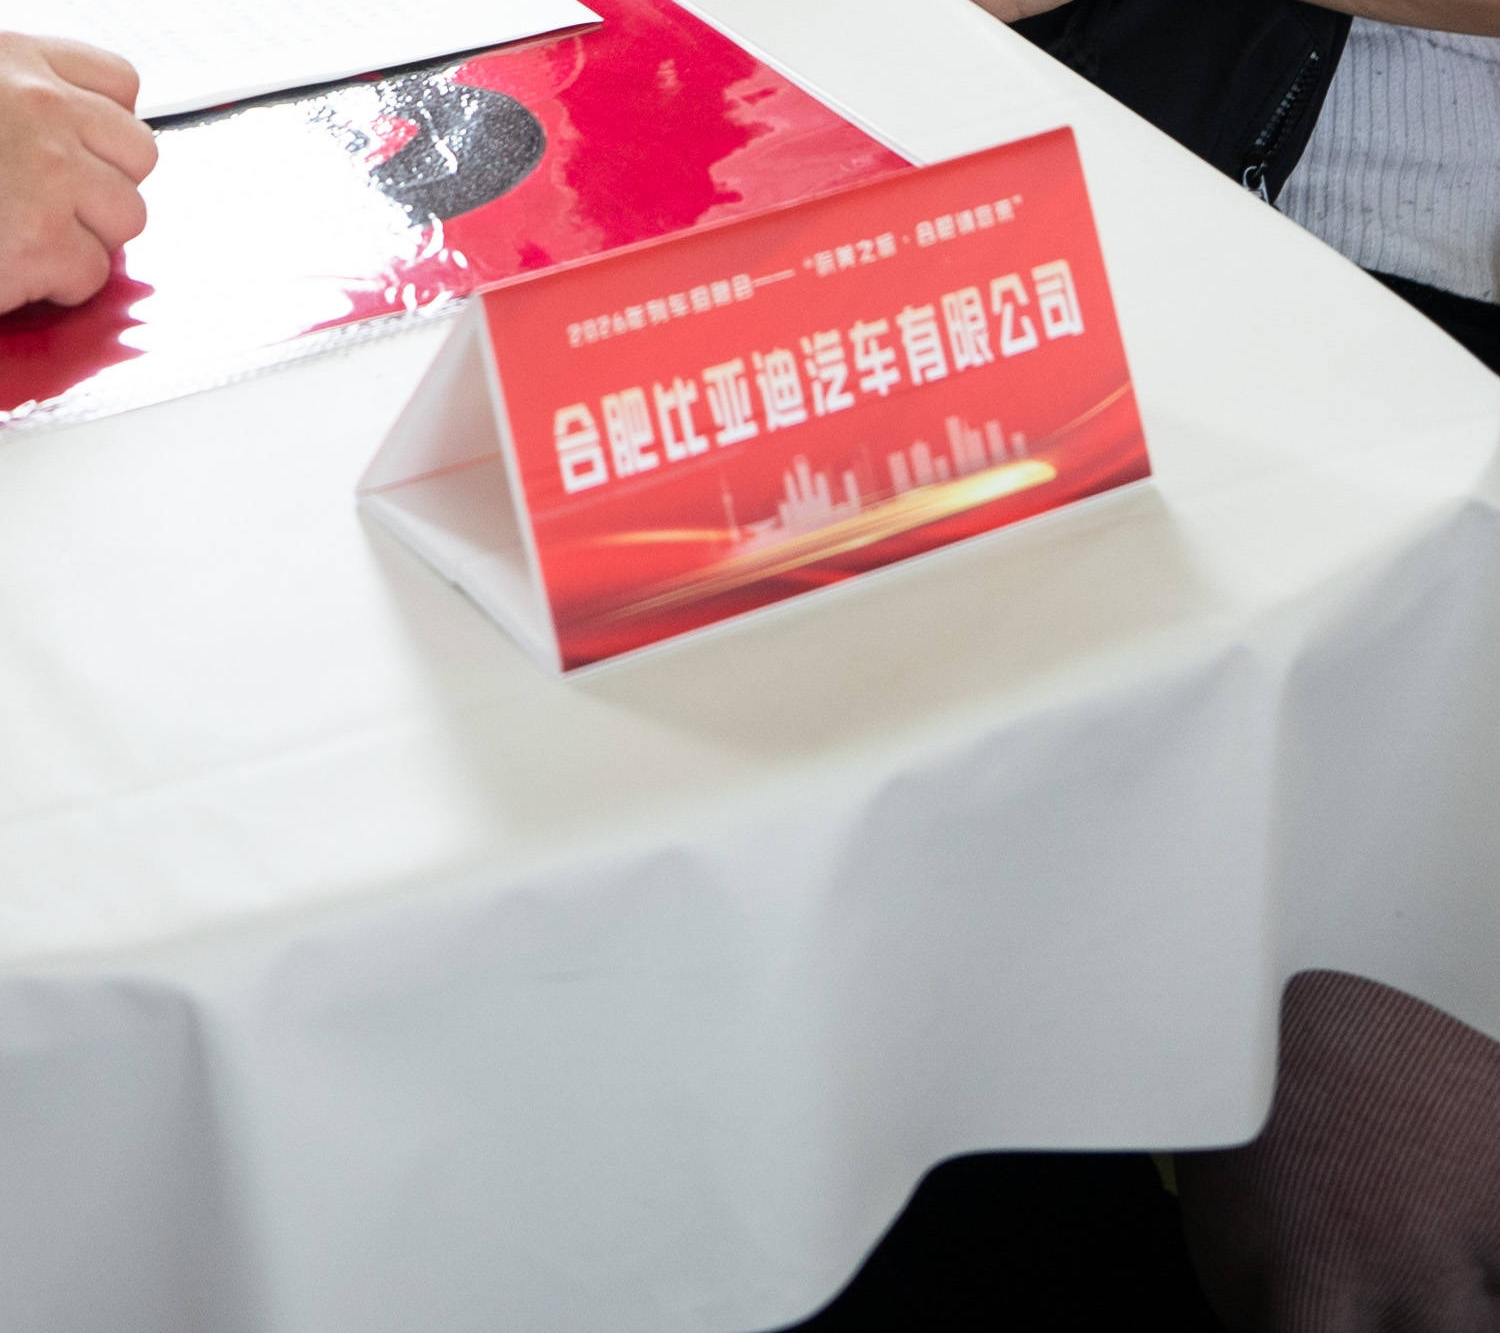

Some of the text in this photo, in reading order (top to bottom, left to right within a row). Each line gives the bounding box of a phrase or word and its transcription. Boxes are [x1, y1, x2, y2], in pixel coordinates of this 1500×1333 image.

[553, 258, 1086, 495] 合肥比亚迪汽车有限公司
